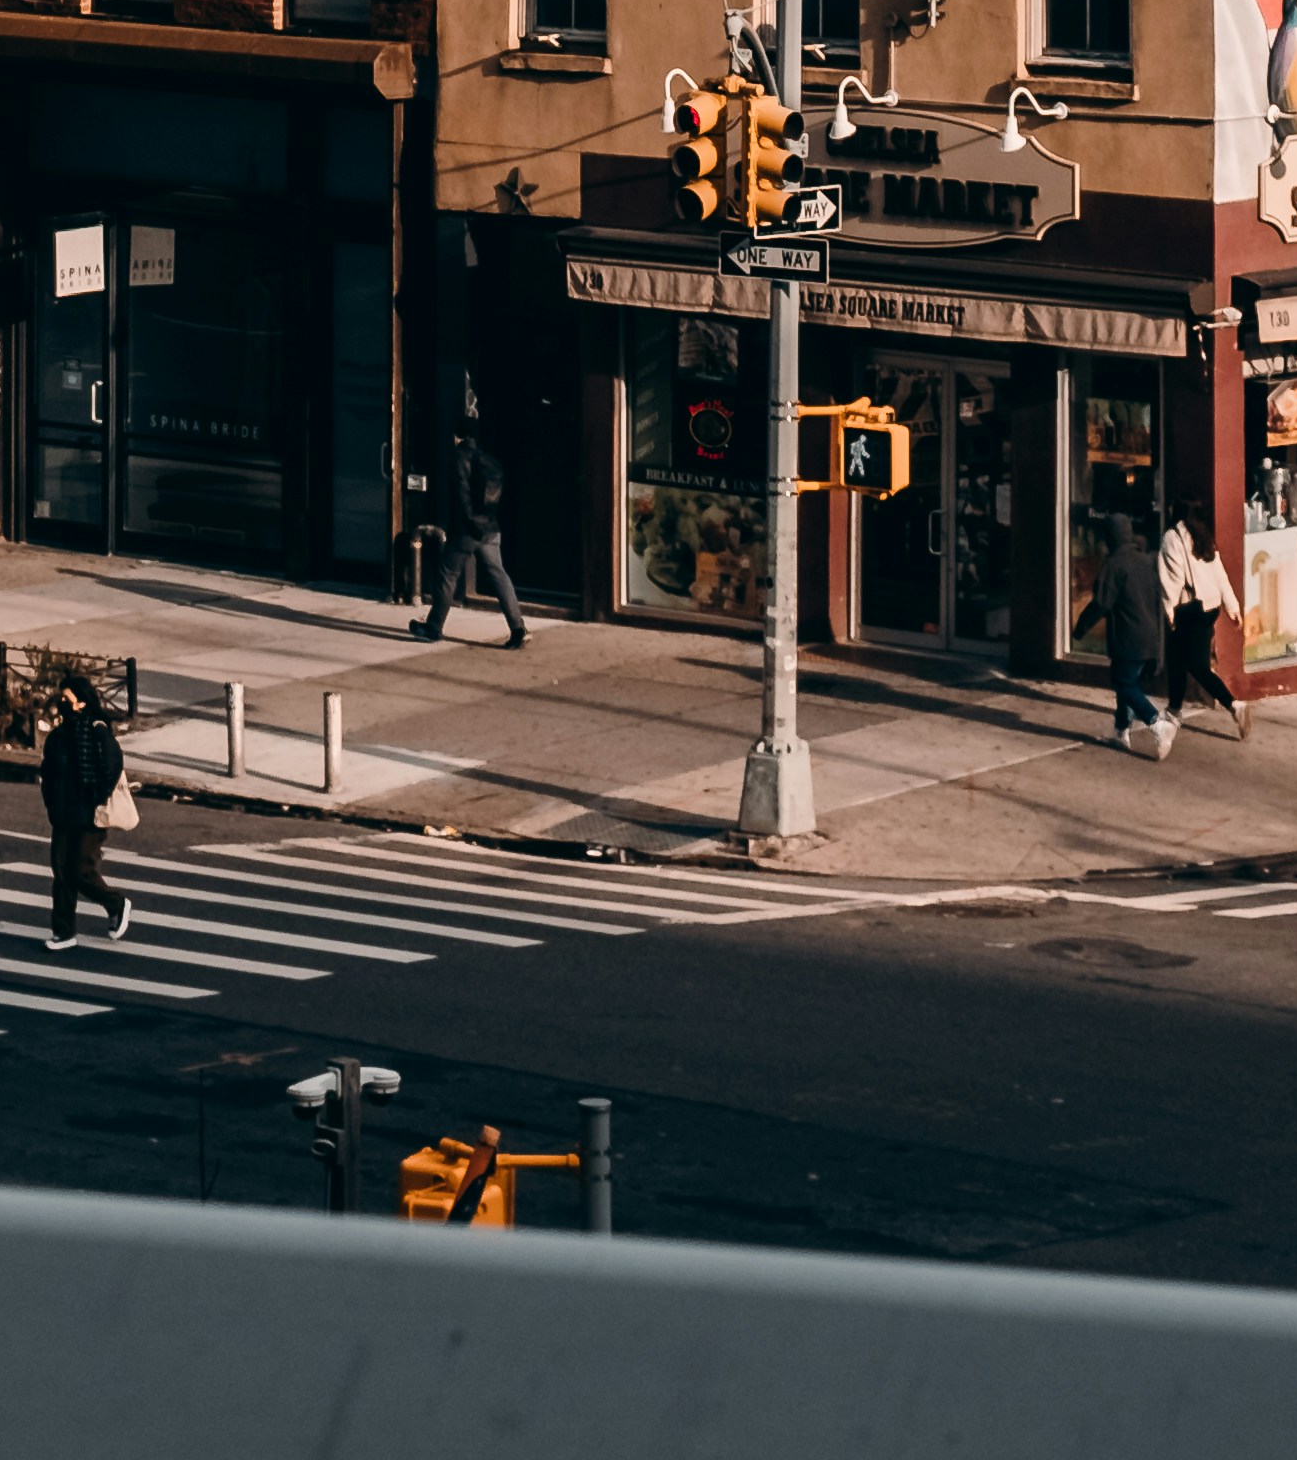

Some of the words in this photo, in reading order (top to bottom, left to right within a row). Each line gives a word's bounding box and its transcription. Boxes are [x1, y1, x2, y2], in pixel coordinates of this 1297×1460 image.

[804, 201, 828, 218] WAY
[883, 173, 1039, 226] MARKET
[737, 247, 768, 265] ONE
[782, 250, 813, 268] WAY
[60, 264, 100, 279] SPINA
[838, 295, 897, 321] SQUARE
[902, 299, 965, 326] MARKET
[1269, 310, 1290, 328] 130
[150, 413, 200, 432] SPINA
[210, 421, 259, 440] BRIDE
[645, 467, 715, 489] BREAKFAST
[719, 476, 728, 491] &
